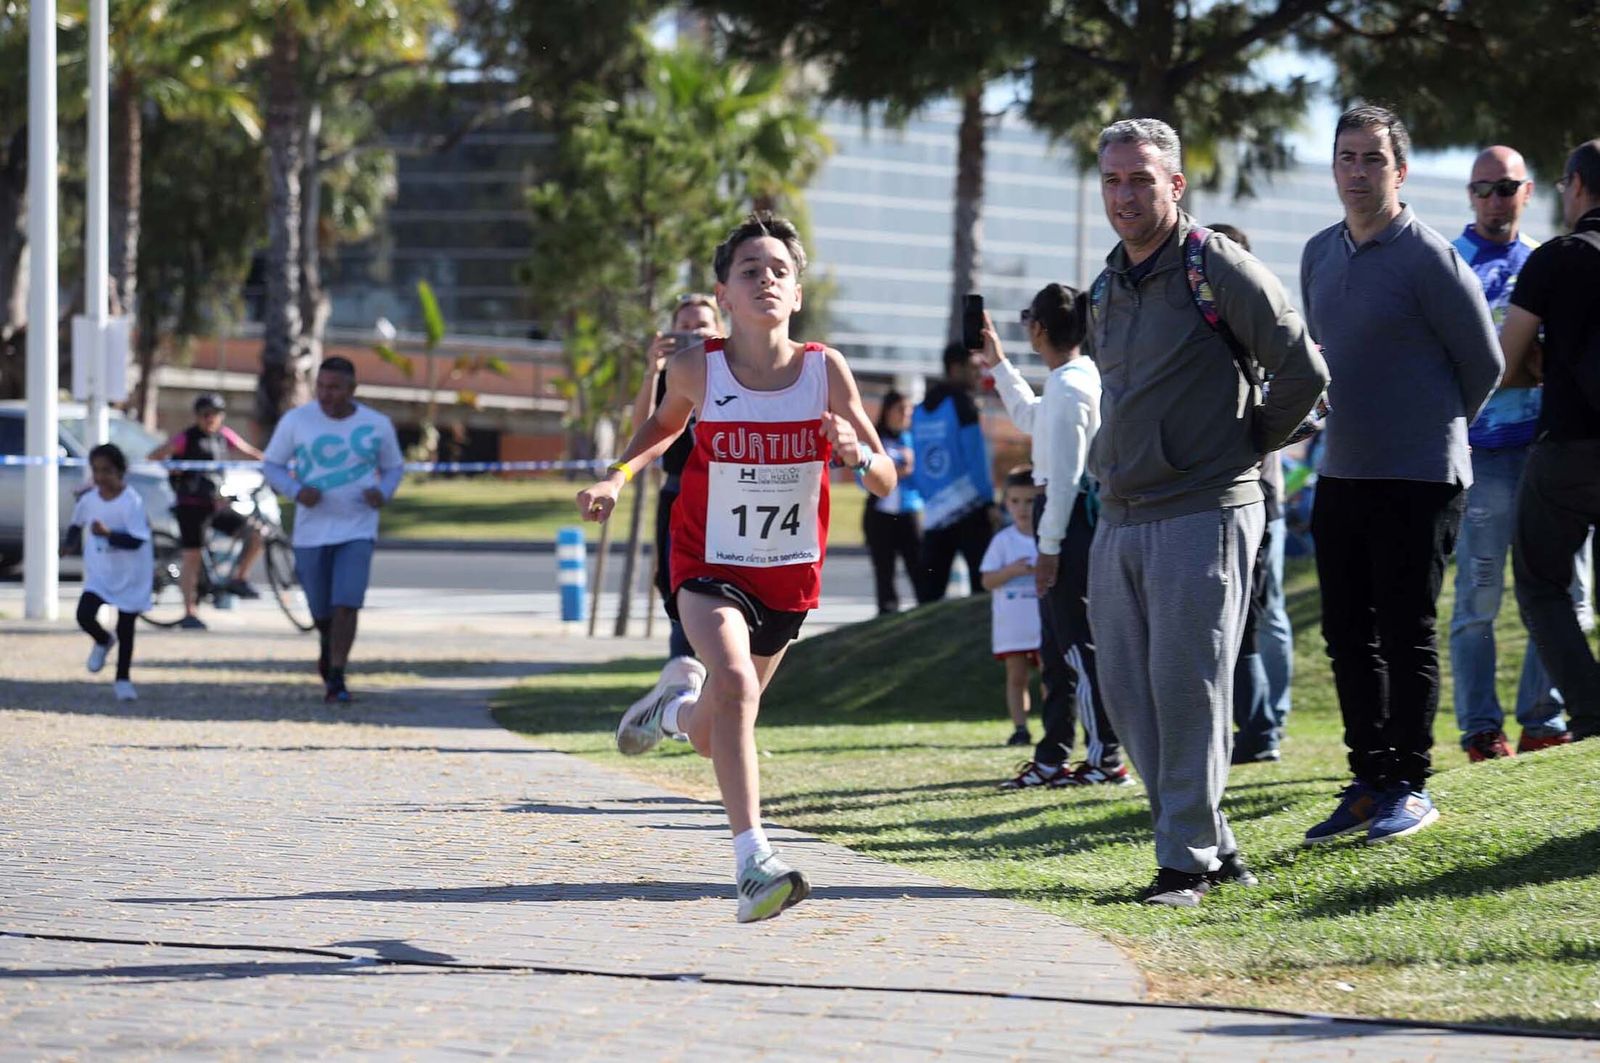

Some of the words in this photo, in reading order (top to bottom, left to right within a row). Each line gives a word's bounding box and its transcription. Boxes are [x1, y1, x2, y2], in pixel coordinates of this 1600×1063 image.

[712, 427, 817, 465] CURTIUS
[732, 503, 800, 540] 174
[716, 552, 744, 562] Huelva
